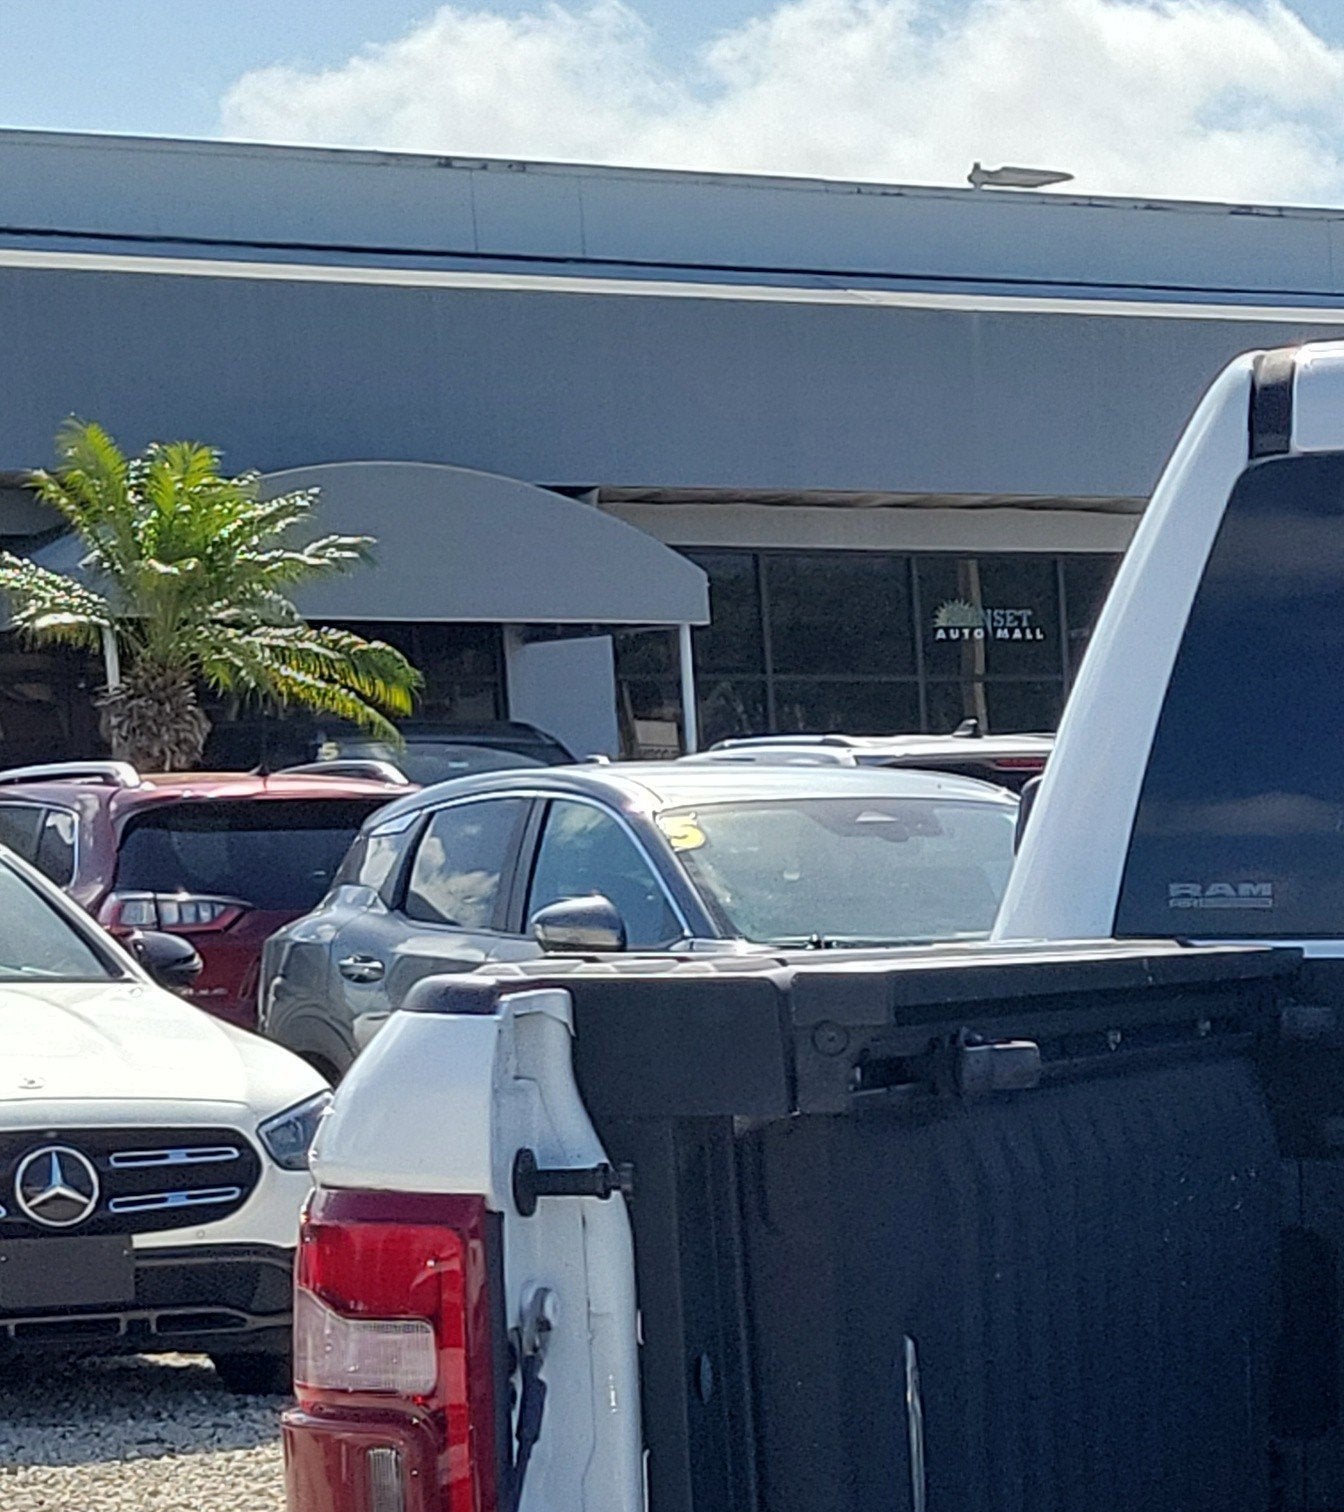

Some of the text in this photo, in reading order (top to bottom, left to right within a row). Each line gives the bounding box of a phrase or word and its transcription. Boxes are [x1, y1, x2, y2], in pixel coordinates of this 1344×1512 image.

[935, 628, 1044, 640] AUTO MALL
[1168, 882, 1273, 897] RAM
